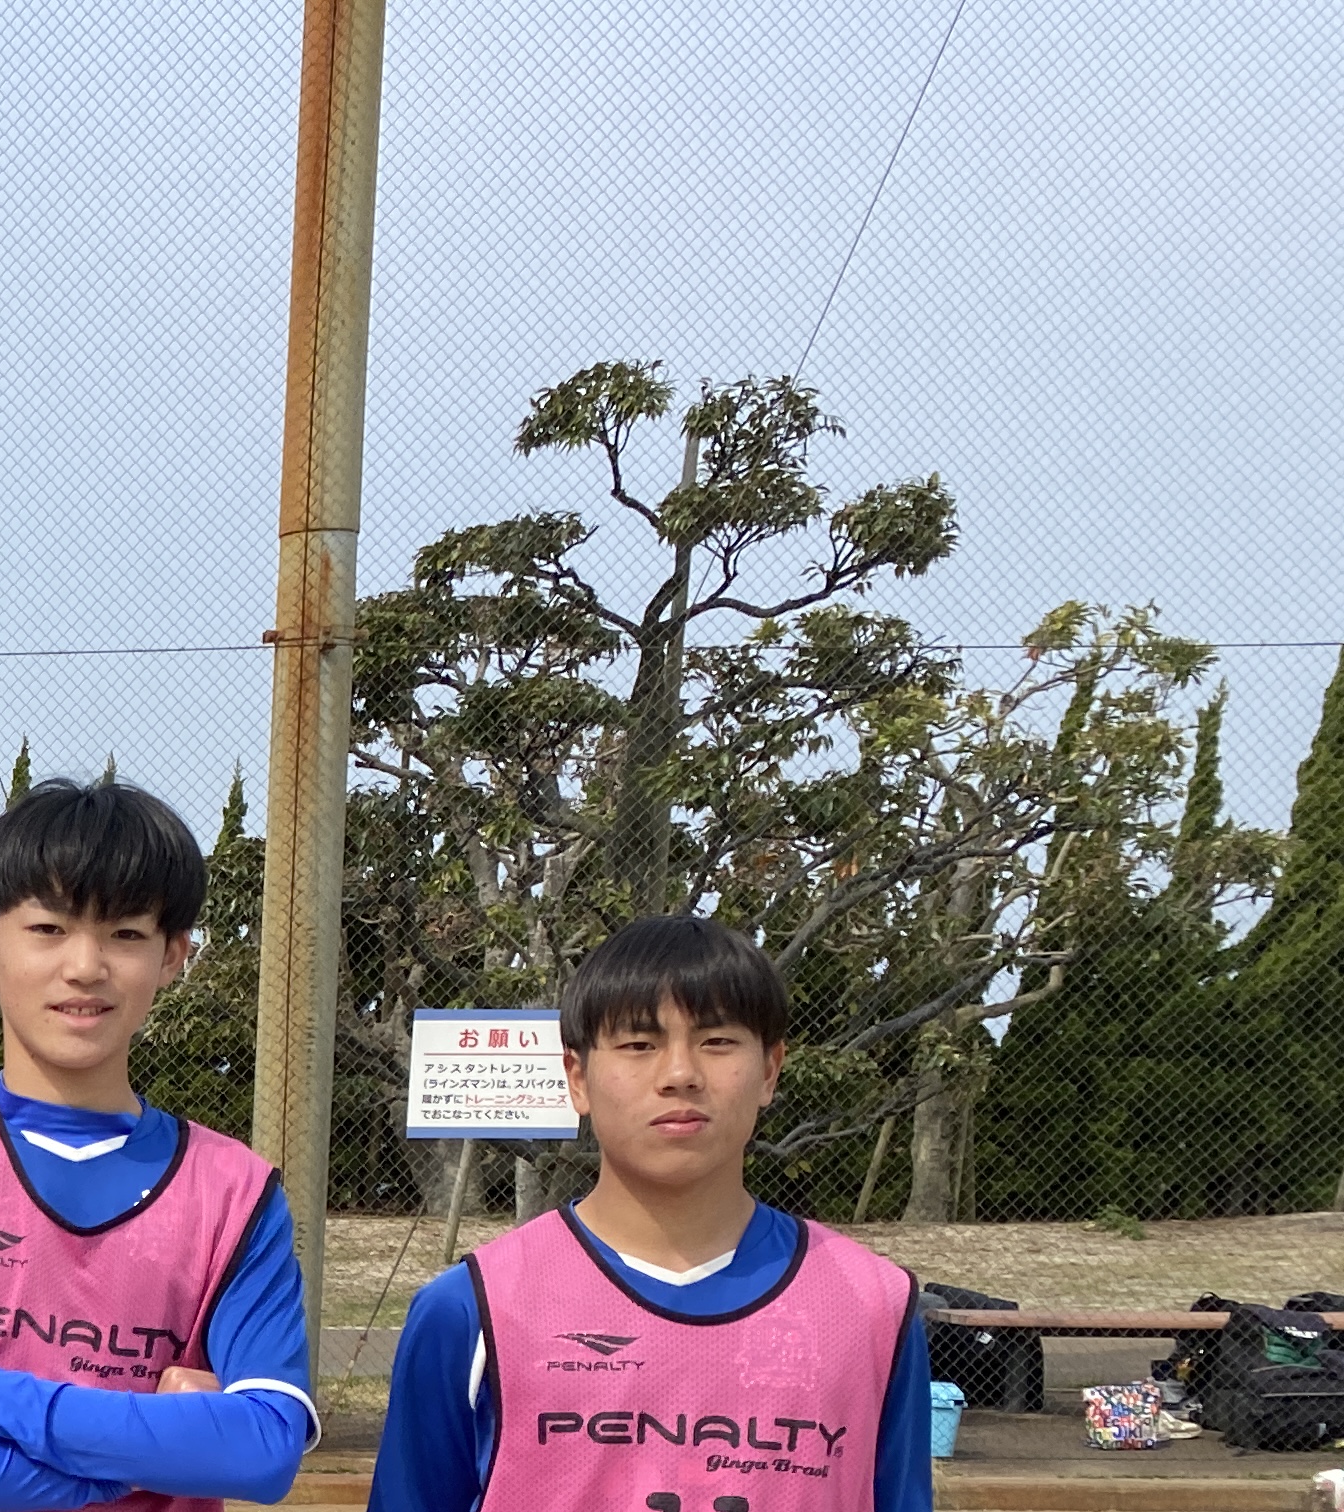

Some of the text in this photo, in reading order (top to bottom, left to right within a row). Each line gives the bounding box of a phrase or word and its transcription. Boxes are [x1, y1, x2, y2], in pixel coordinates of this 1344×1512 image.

[458, 1029, 539, 1048] お願い
[424, 1063, 547, 1074] アシスタントレフリー
[421, 1109, 530, 1120] でおこなってください。
[546, 1361, 646, 1372] PENALTY
[537, 1411, 848, 1457] PENALTY
